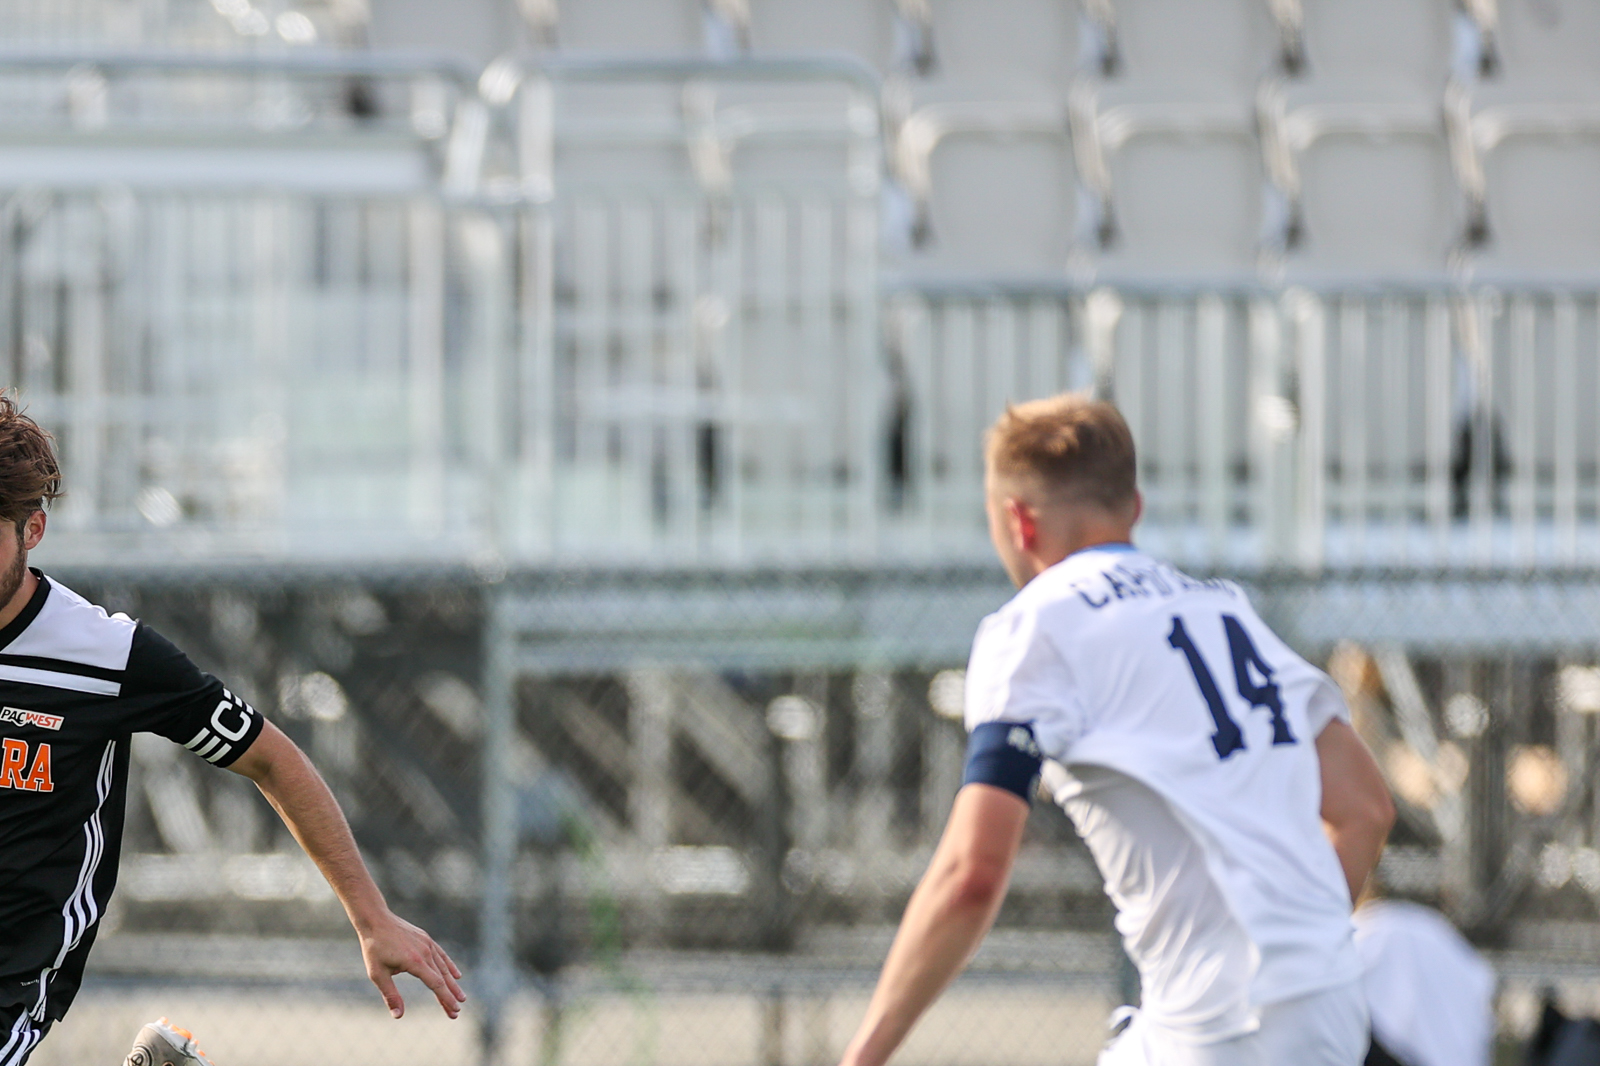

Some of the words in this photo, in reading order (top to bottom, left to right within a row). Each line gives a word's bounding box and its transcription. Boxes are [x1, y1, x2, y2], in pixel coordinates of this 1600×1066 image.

[1167, 612, 1298, 759] 14
[0, 708, 62, 728] PACWEST
[210, 699, 252, 742] C
